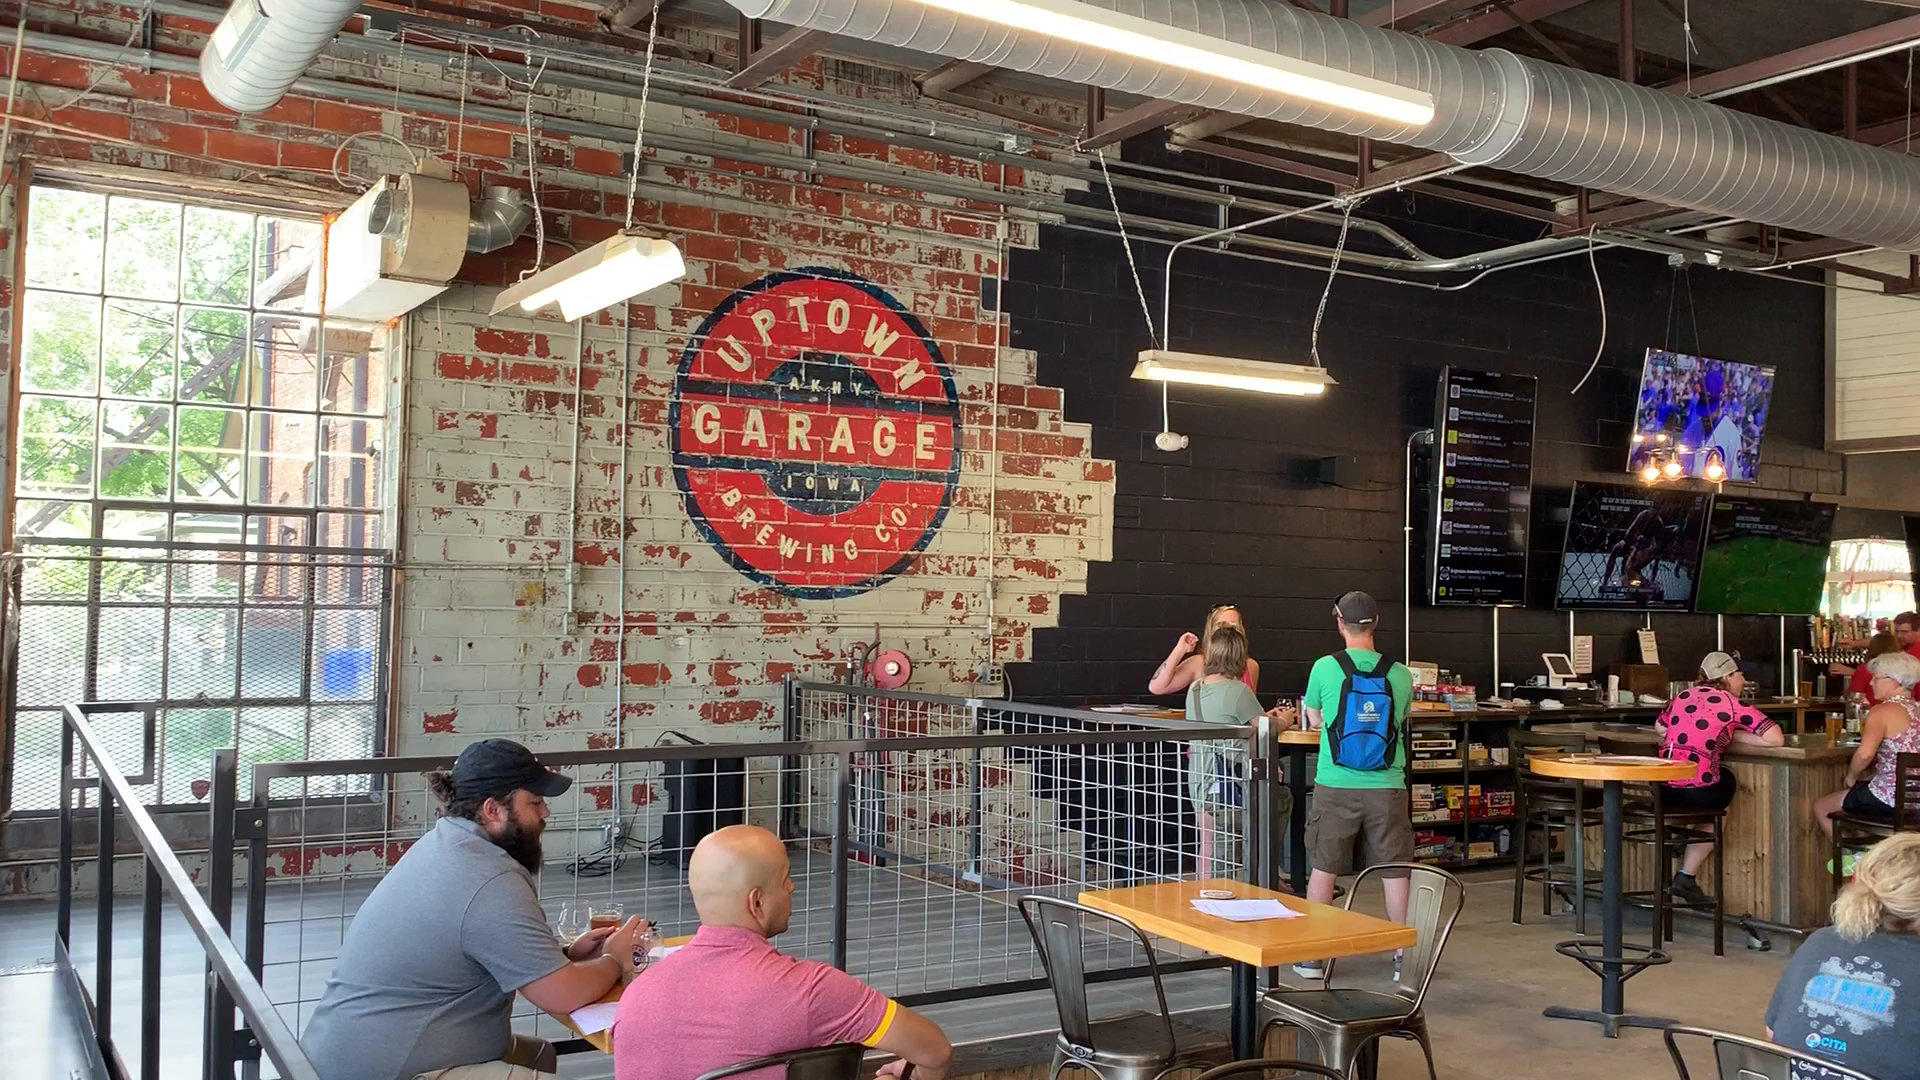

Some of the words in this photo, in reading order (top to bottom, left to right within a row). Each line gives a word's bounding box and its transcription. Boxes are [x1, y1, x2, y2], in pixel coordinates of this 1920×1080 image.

[716, 296, 926, 391] UPTOWN
[694, 404, 936, 460] GARAGE
[787, 475, 860, 492] IOWA
[720, 487, 859, 564] BREWING
[875, 502, 918, 543] CO.
[1821, 1037, 1847, 1052] CITA
